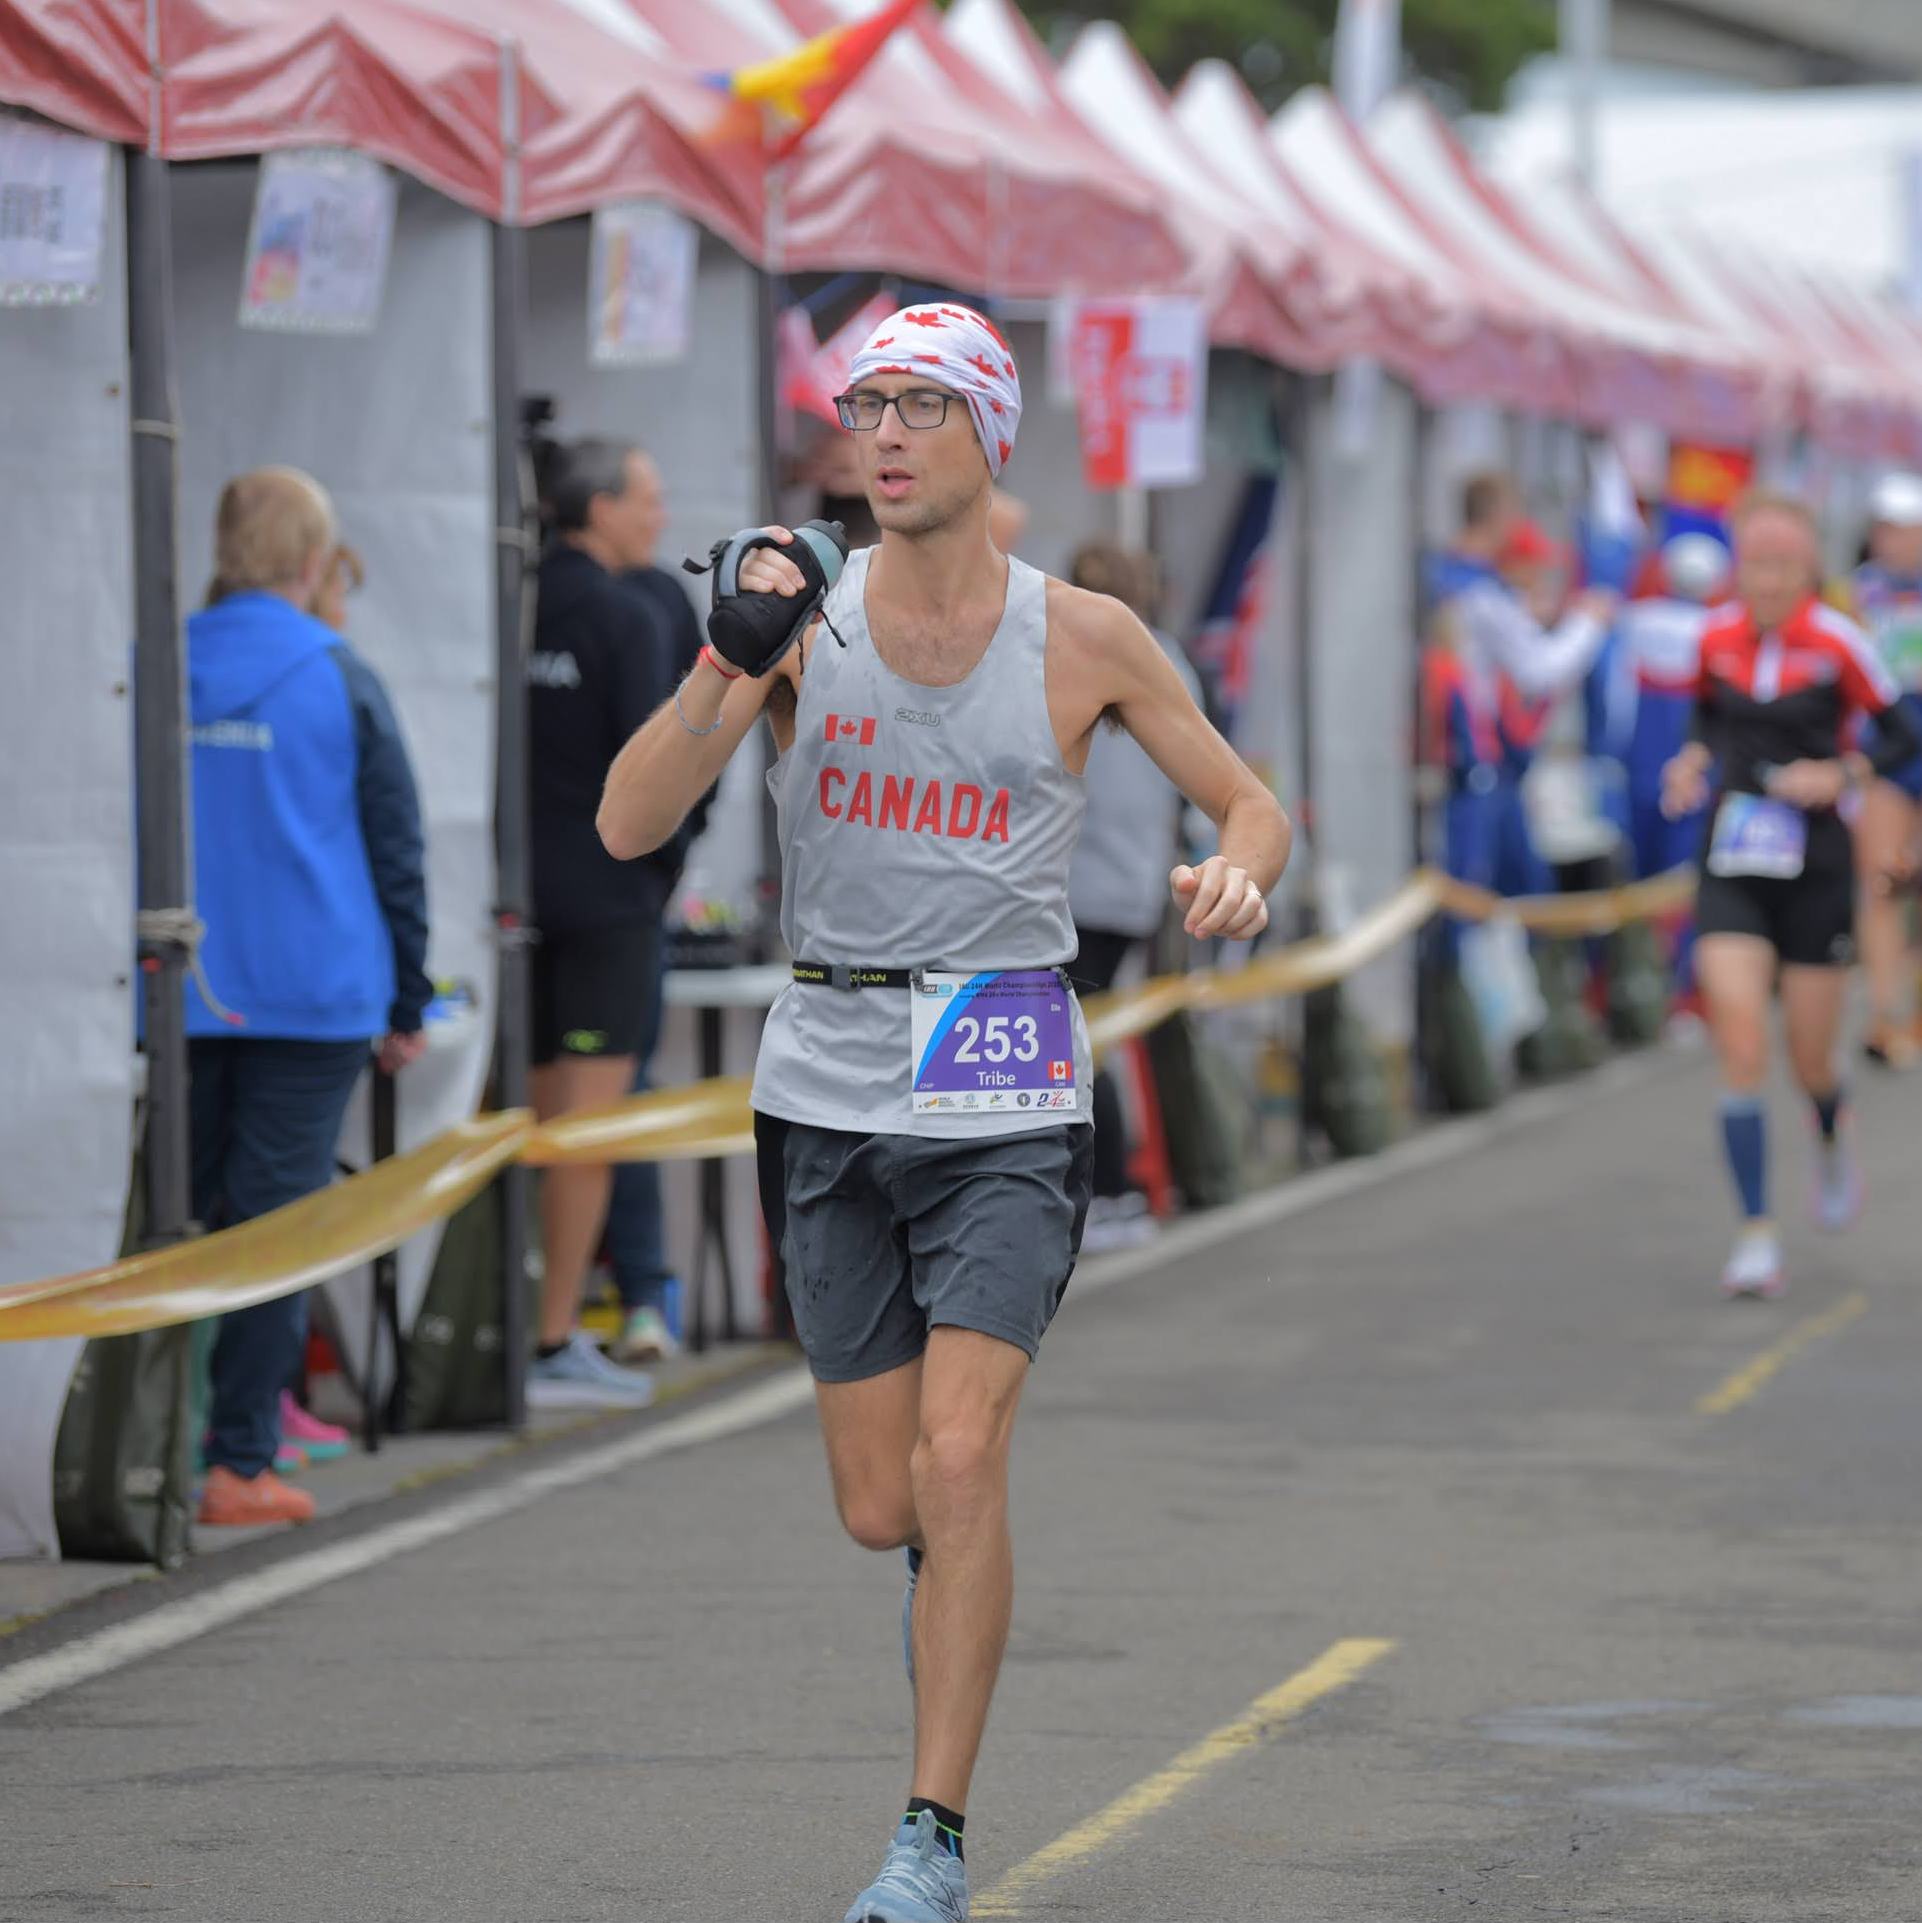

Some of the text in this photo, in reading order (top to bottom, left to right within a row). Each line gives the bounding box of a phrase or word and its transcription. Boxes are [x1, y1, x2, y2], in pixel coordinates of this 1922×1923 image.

[895, 707, 941, 728] 2XU
[819, 766, 1010, 843] CANADA
[954, 1015, 1039, 1063] 253
[976, 1071, 1016, 1086] Tribe
